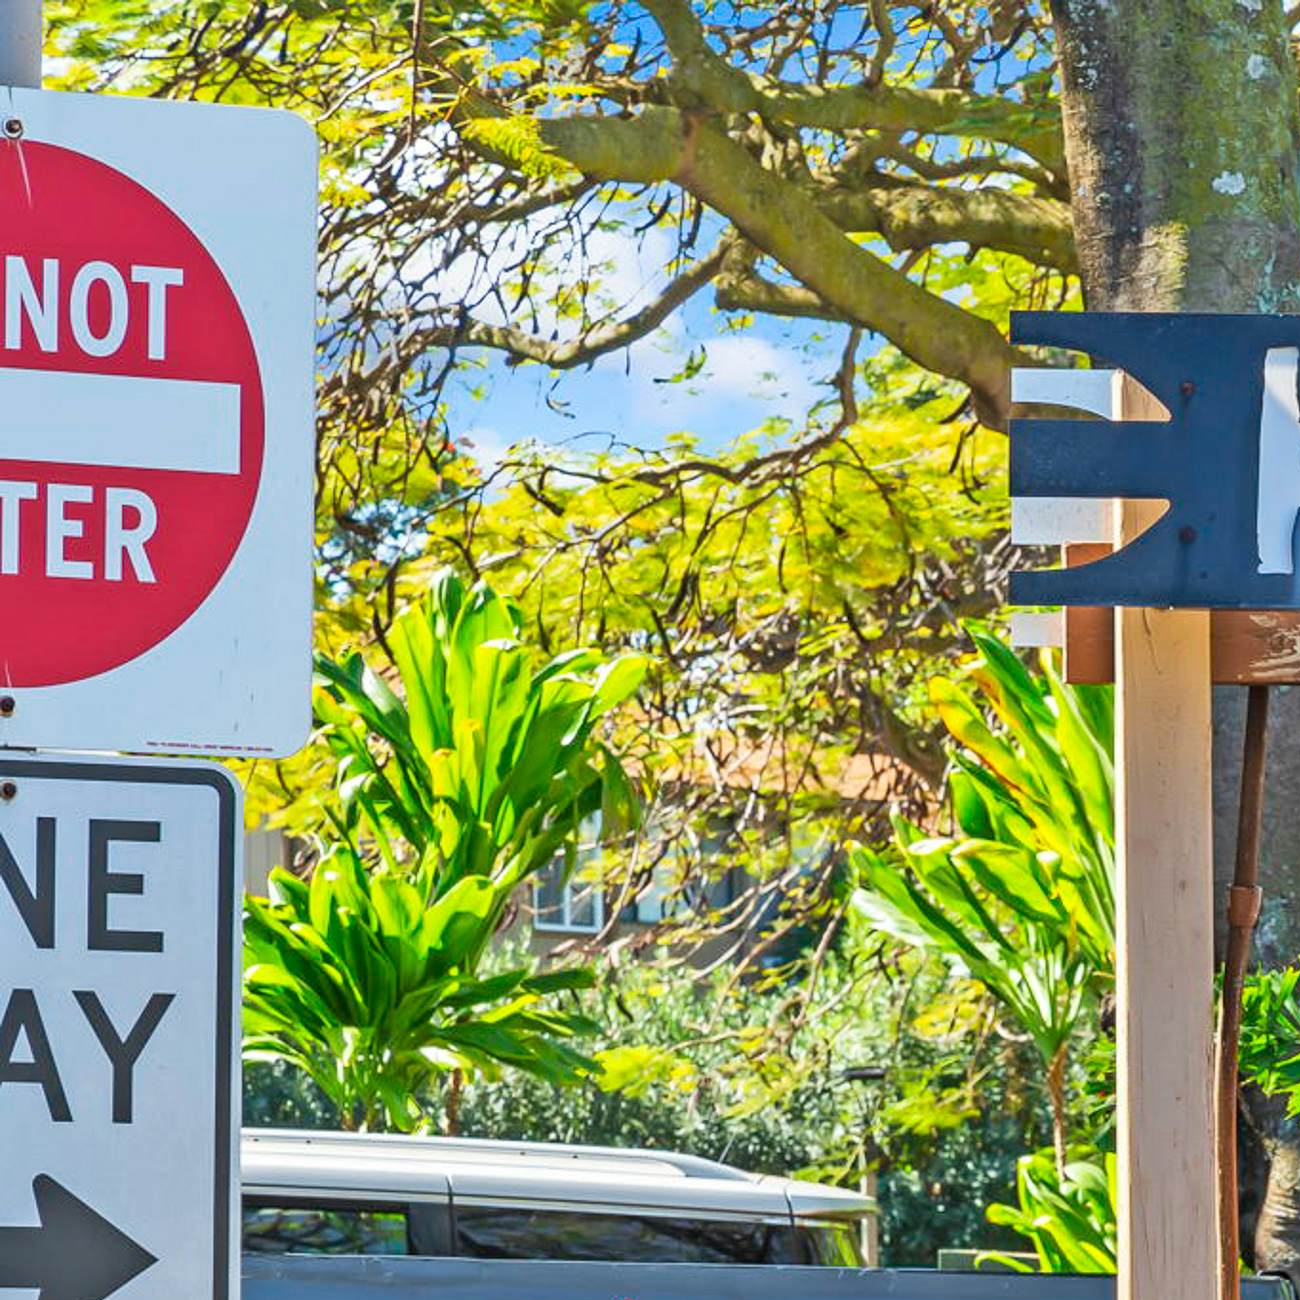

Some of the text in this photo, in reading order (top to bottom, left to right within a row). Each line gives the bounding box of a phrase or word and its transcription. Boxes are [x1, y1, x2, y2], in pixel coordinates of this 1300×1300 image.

[3, 255, 185, 362] NOT
[0, 479, 158, 584] TER
[0, 816, 165, 953] NE
[0, 988, 178, 1124] AY
